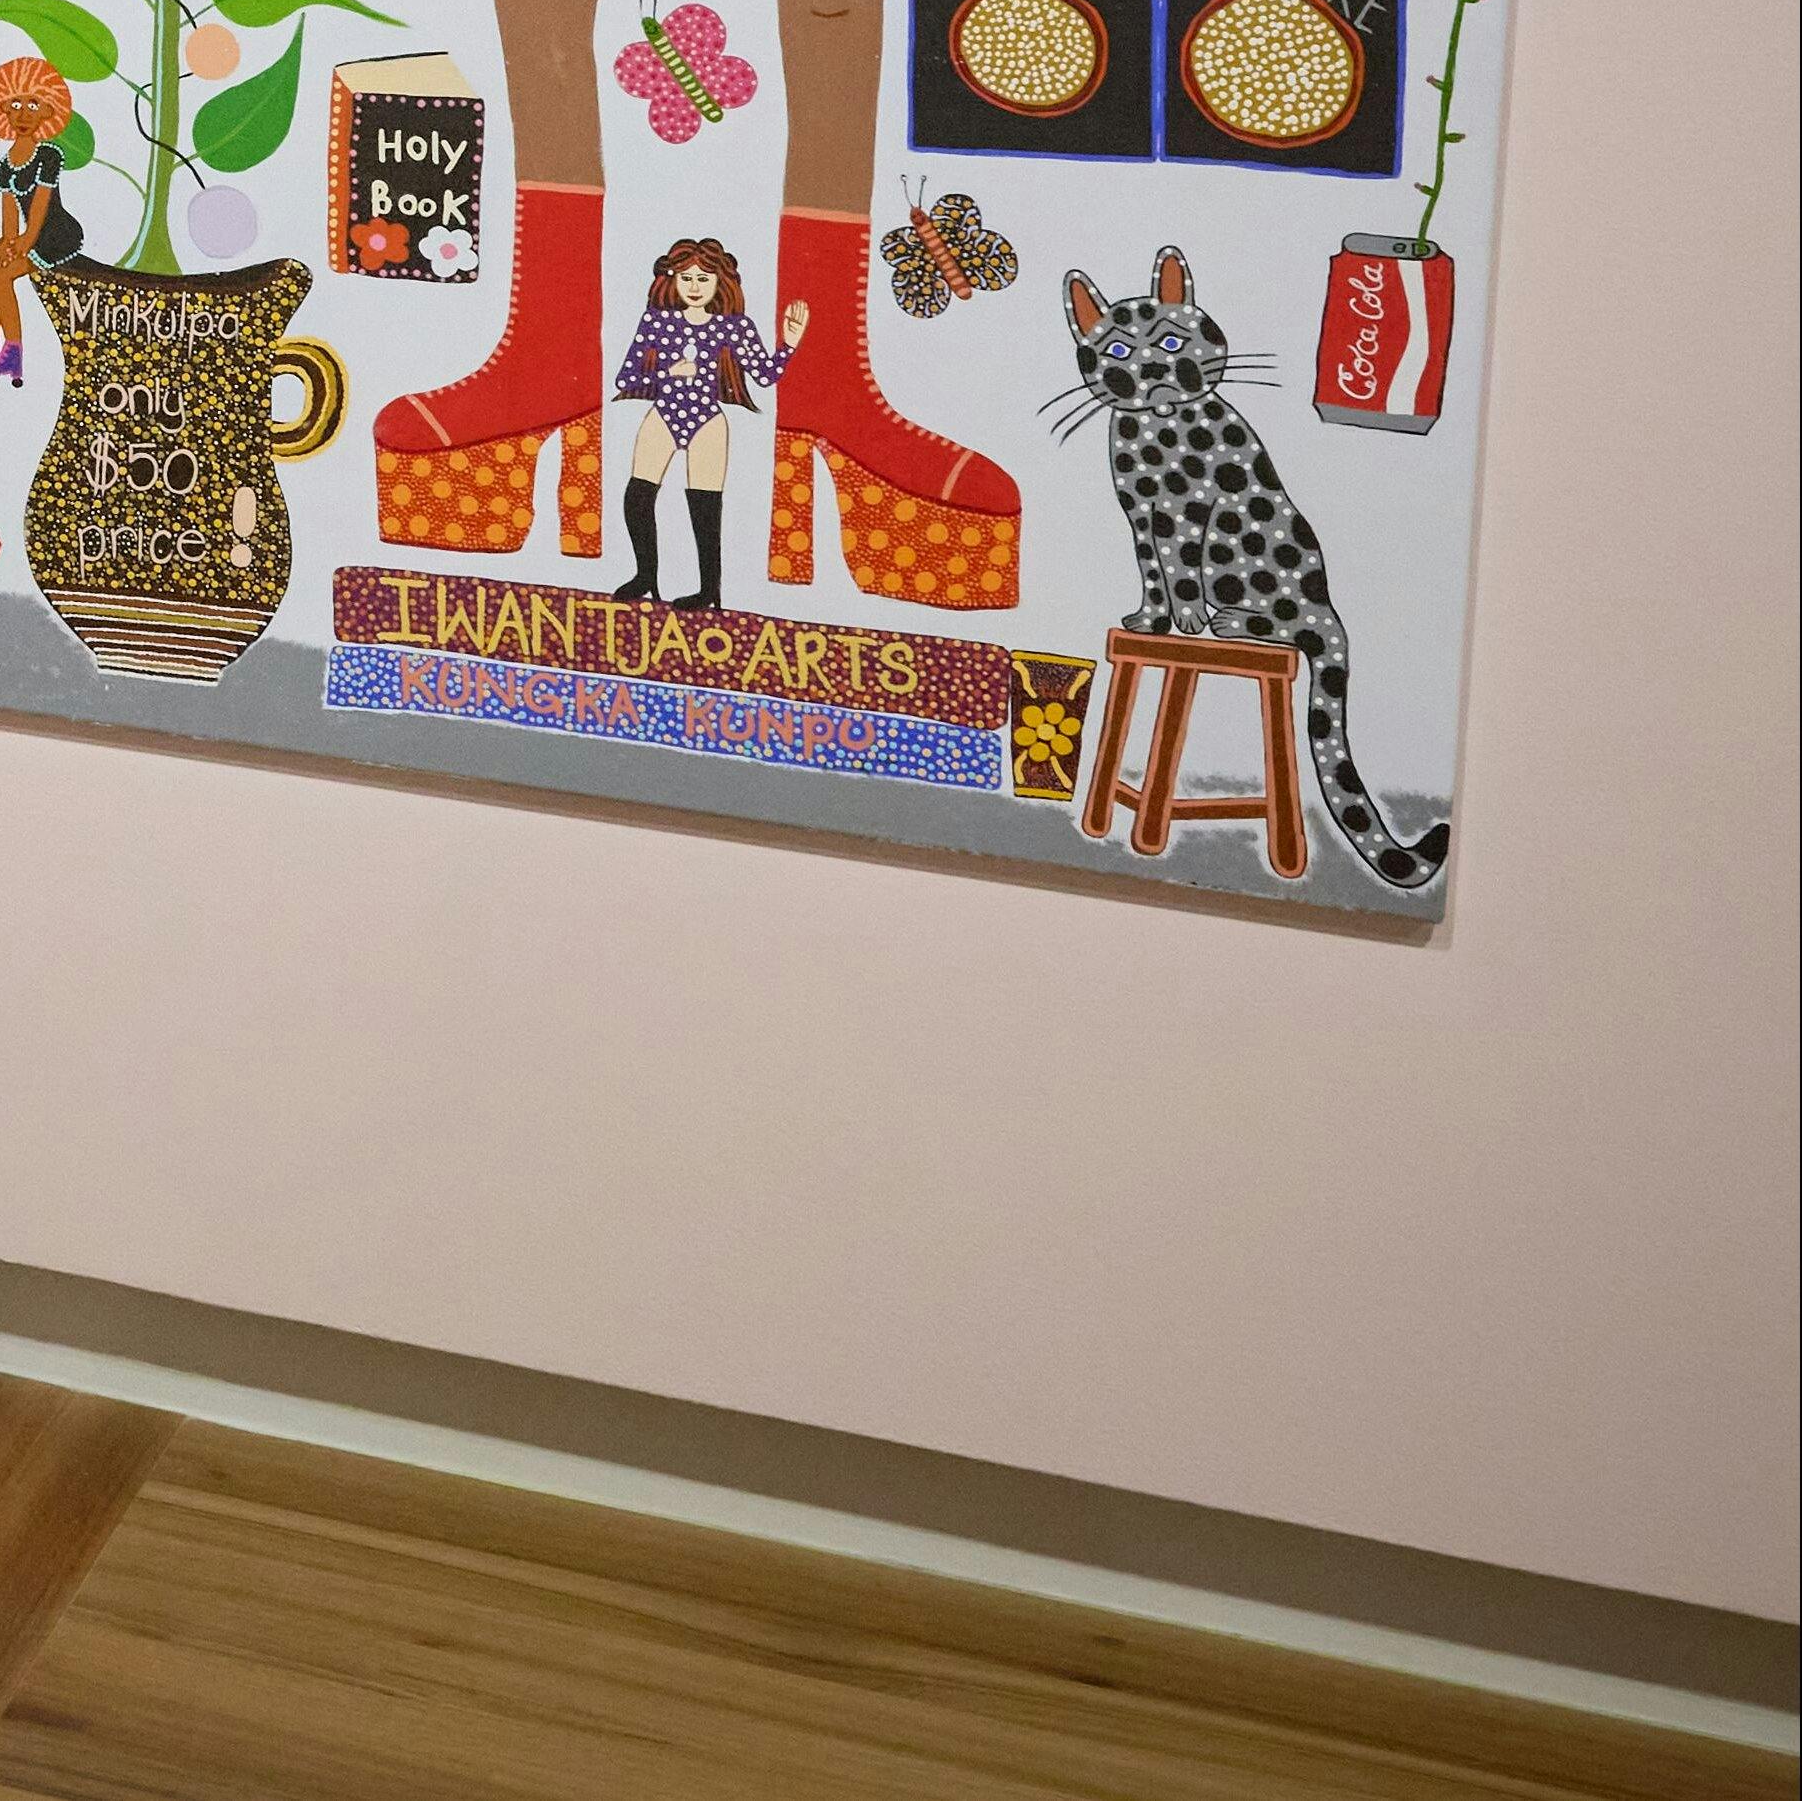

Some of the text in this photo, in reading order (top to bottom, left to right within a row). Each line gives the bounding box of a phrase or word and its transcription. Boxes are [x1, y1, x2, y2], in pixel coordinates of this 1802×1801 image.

[378, 128, 468, 175] Holy
[1337, 262, 1385, 401] Coca Cola
[98, 377, 186, 435] only
[85, 432, 199, 497] $50
[398, 654, 641, 726] KUNGKA
